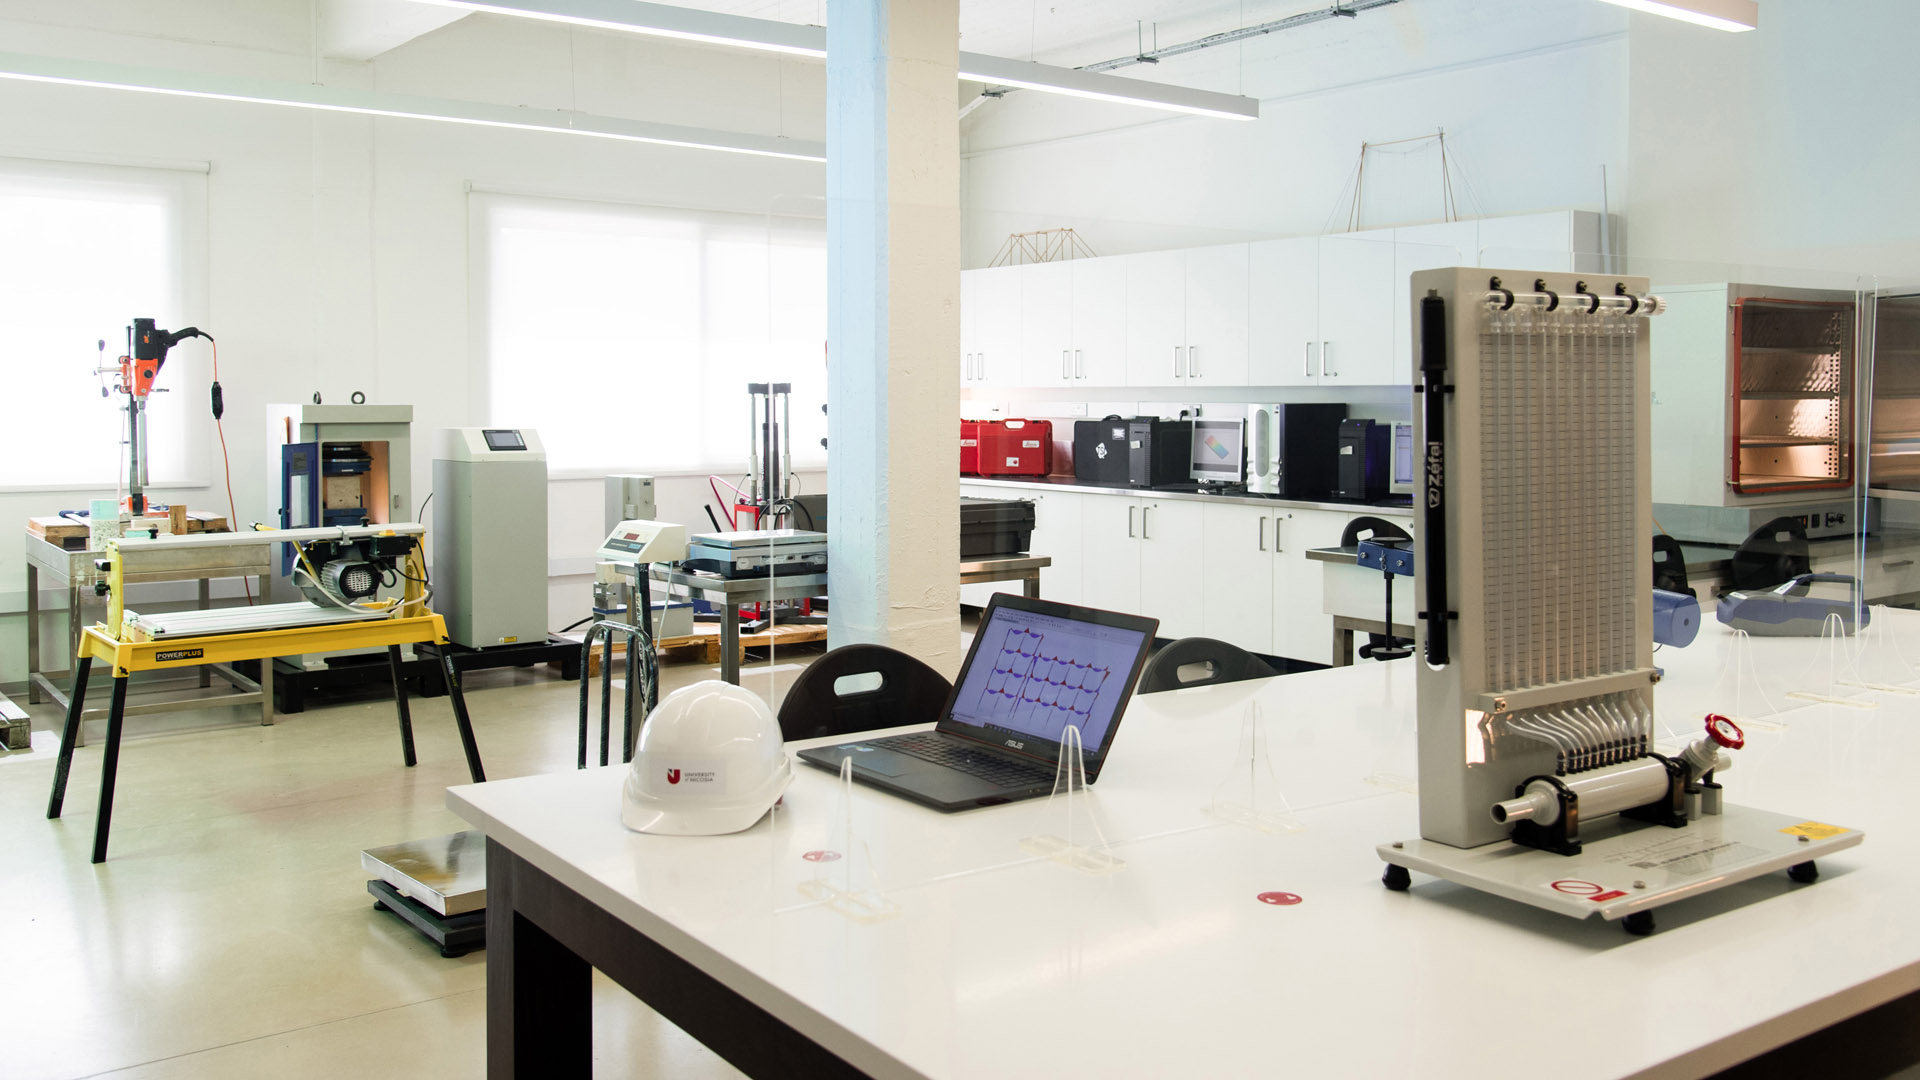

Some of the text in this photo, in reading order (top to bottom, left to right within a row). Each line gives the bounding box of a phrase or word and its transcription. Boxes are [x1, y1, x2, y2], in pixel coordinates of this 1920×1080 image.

[1427, 442, 1440, 486] Zéfal
[156, 650, 202, 659] POWERPLUS
[1004, 739, 1024, 749] ASUS
